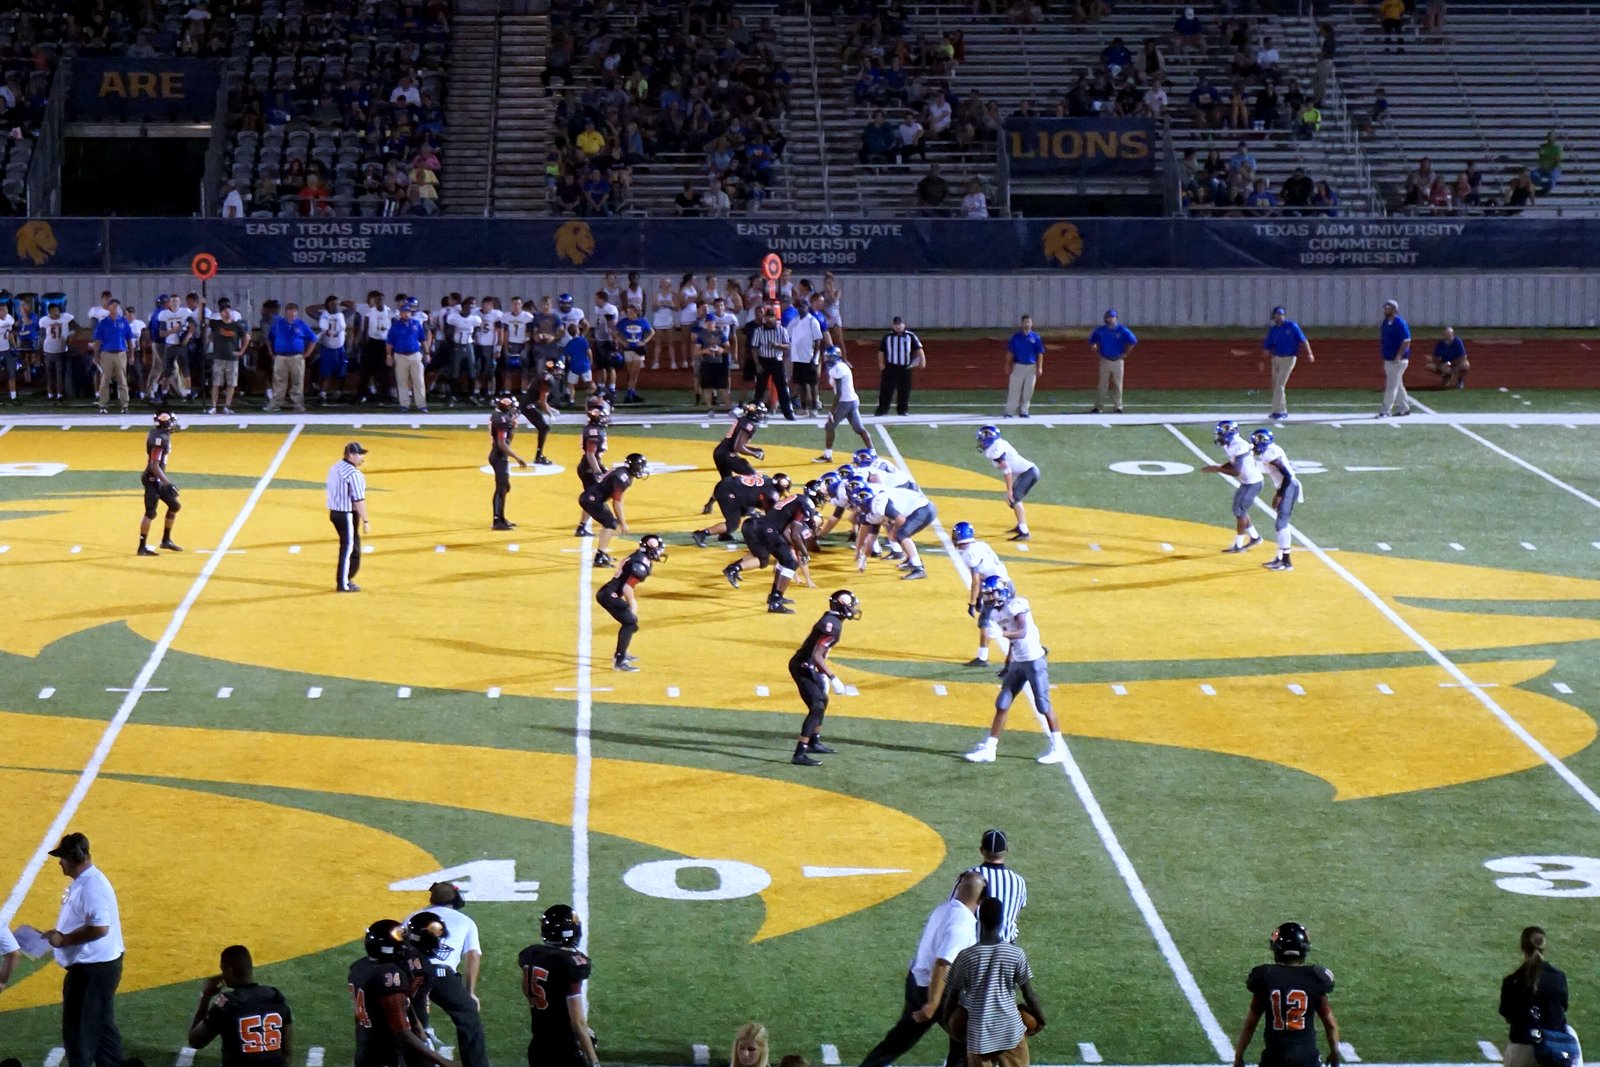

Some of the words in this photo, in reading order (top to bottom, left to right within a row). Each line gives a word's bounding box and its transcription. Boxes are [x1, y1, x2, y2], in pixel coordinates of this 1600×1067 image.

[98, 71, 185, 98] ARE
[1009, 130, 1149, 159] LIONS
[246, 223, 290, 235] EAST
[297, 223, 353, 235] TEXAS
[359, 223, 413, 235] STATE
[736, 224, 780, 236] EAST
[788, 224, 843, 236] TEXAS
[851, 224, 902, 236] STATE
[1254, 224, 1309, 236] TEXAS
[1316, 224, 1355, 236] A&M
[1361, 224, 1465, 236] UNIVERSITY
[293, 237, 371, 249] COLLEGE
[767, 238, 872, 250] UNIVERSITY
[1309, 238, 1410, 250] COMMERCE
[292, 251, 367, 263] 1957-1962
[782, 252, 857, 264] 1962-1996
[1300, 252, 1420, 264] 1996-PRESENT
[384, 972, 400, 987] 34
[522, 964, 549, 1010] 15
[1270, 989, 1308, 1031] 12
[239, 1012, 283, 1053] 56
